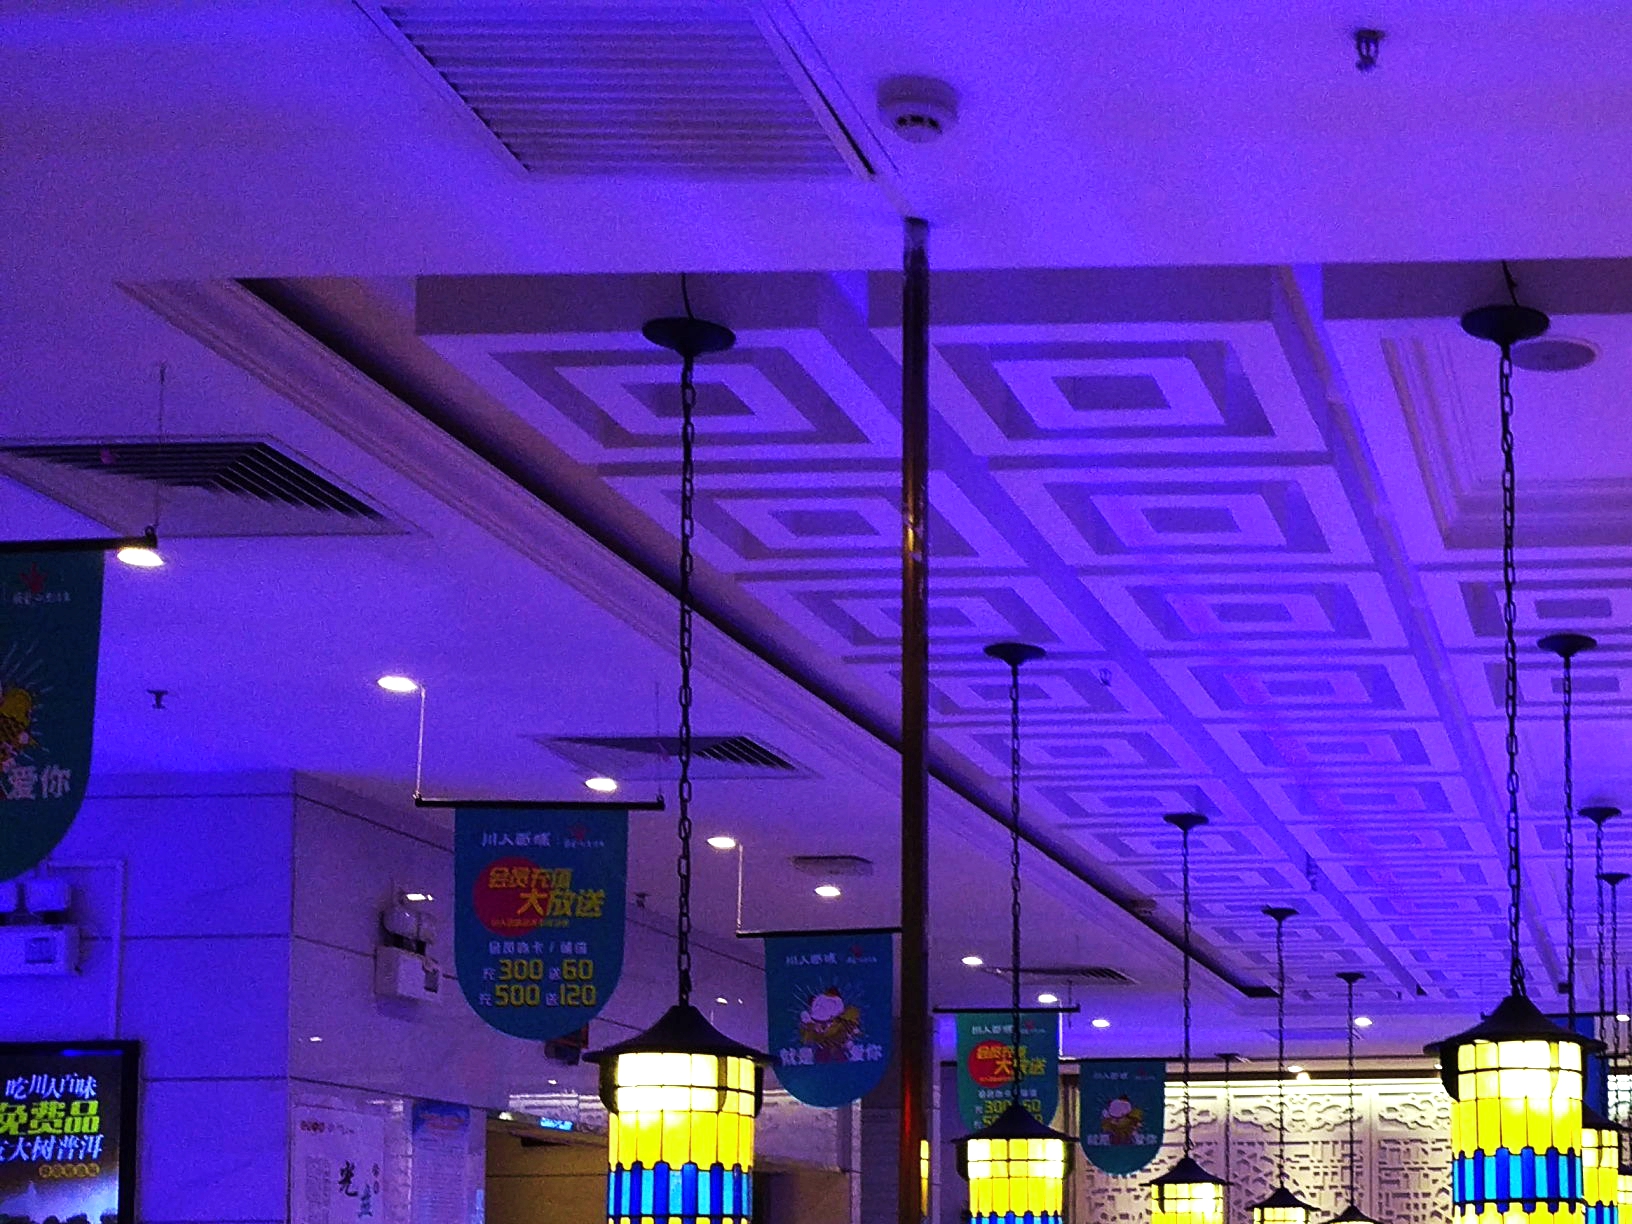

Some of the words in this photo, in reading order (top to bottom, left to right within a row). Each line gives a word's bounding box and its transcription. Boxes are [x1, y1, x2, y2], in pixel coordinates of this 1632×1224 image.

[488, 866, 573, 889] 会员充值
[516, 888, 606, 918] 大放送
